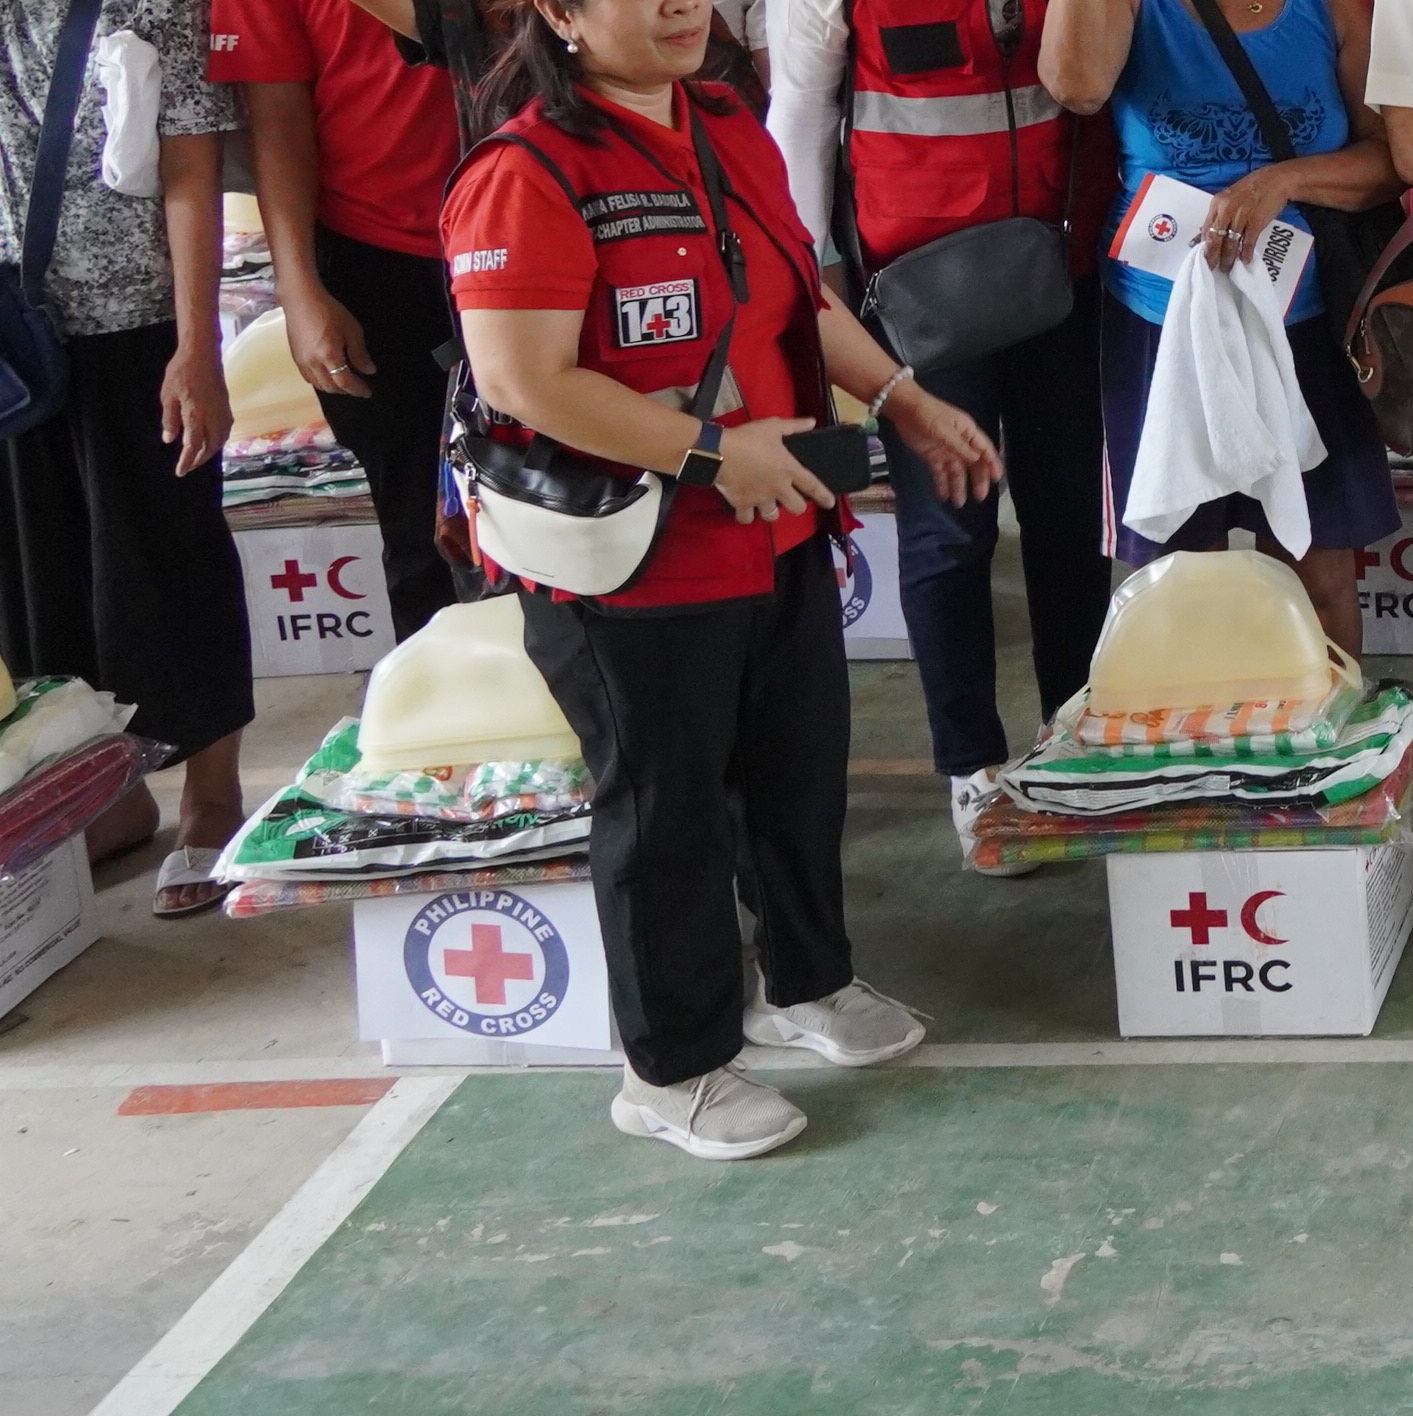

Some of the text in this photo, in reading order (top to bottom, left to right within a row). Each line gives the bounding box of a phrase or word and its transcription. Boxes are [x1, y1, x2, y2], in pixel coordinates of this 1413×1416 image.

[594, 218, 642, 240] CHAPTER
[473, 248, 508, 273] STAFF
[620, 283, 690, 300] RED CROSS
[621, 295, 692, 344] 143
[277, 610, 375, 642] IFRC
[414, 890, 554, 943] PHILIPPINE
[1174, 958, 1294, 994] IFRC
[420, 986, 558, 1035] RED CROSS
